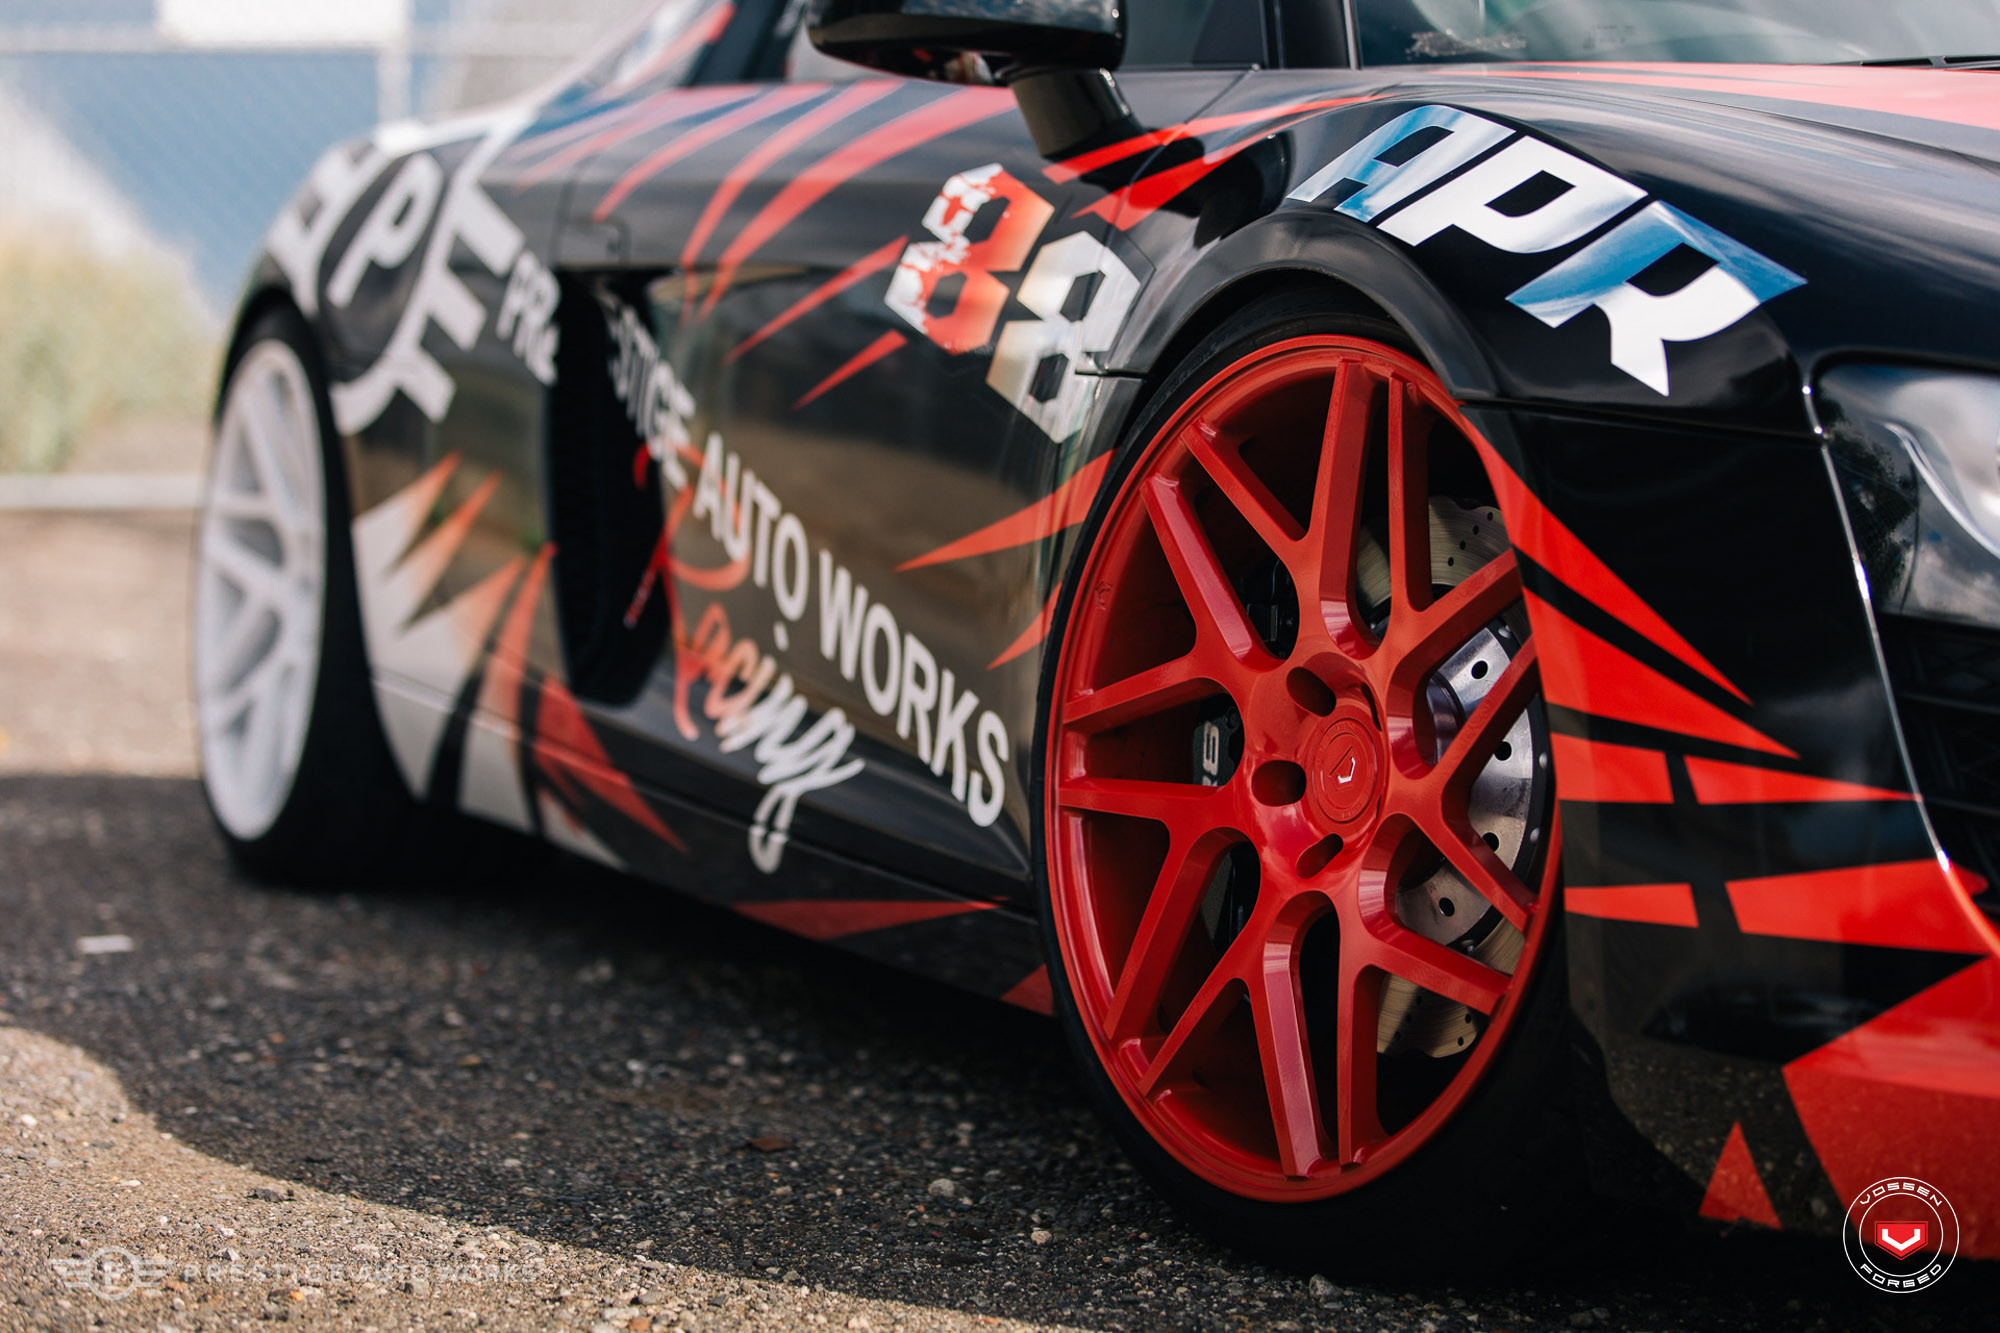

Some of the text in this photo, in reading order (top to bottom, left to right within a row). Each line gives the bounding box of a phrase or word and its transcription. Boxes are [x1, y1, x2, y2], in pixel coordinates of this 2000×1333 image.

[884, 162, 1142, 444] 88
[1286, 104, 1808, 397] APR
[692, 432, 812, 622] AUTO
[818, 548, 1011, 828] WORKS
